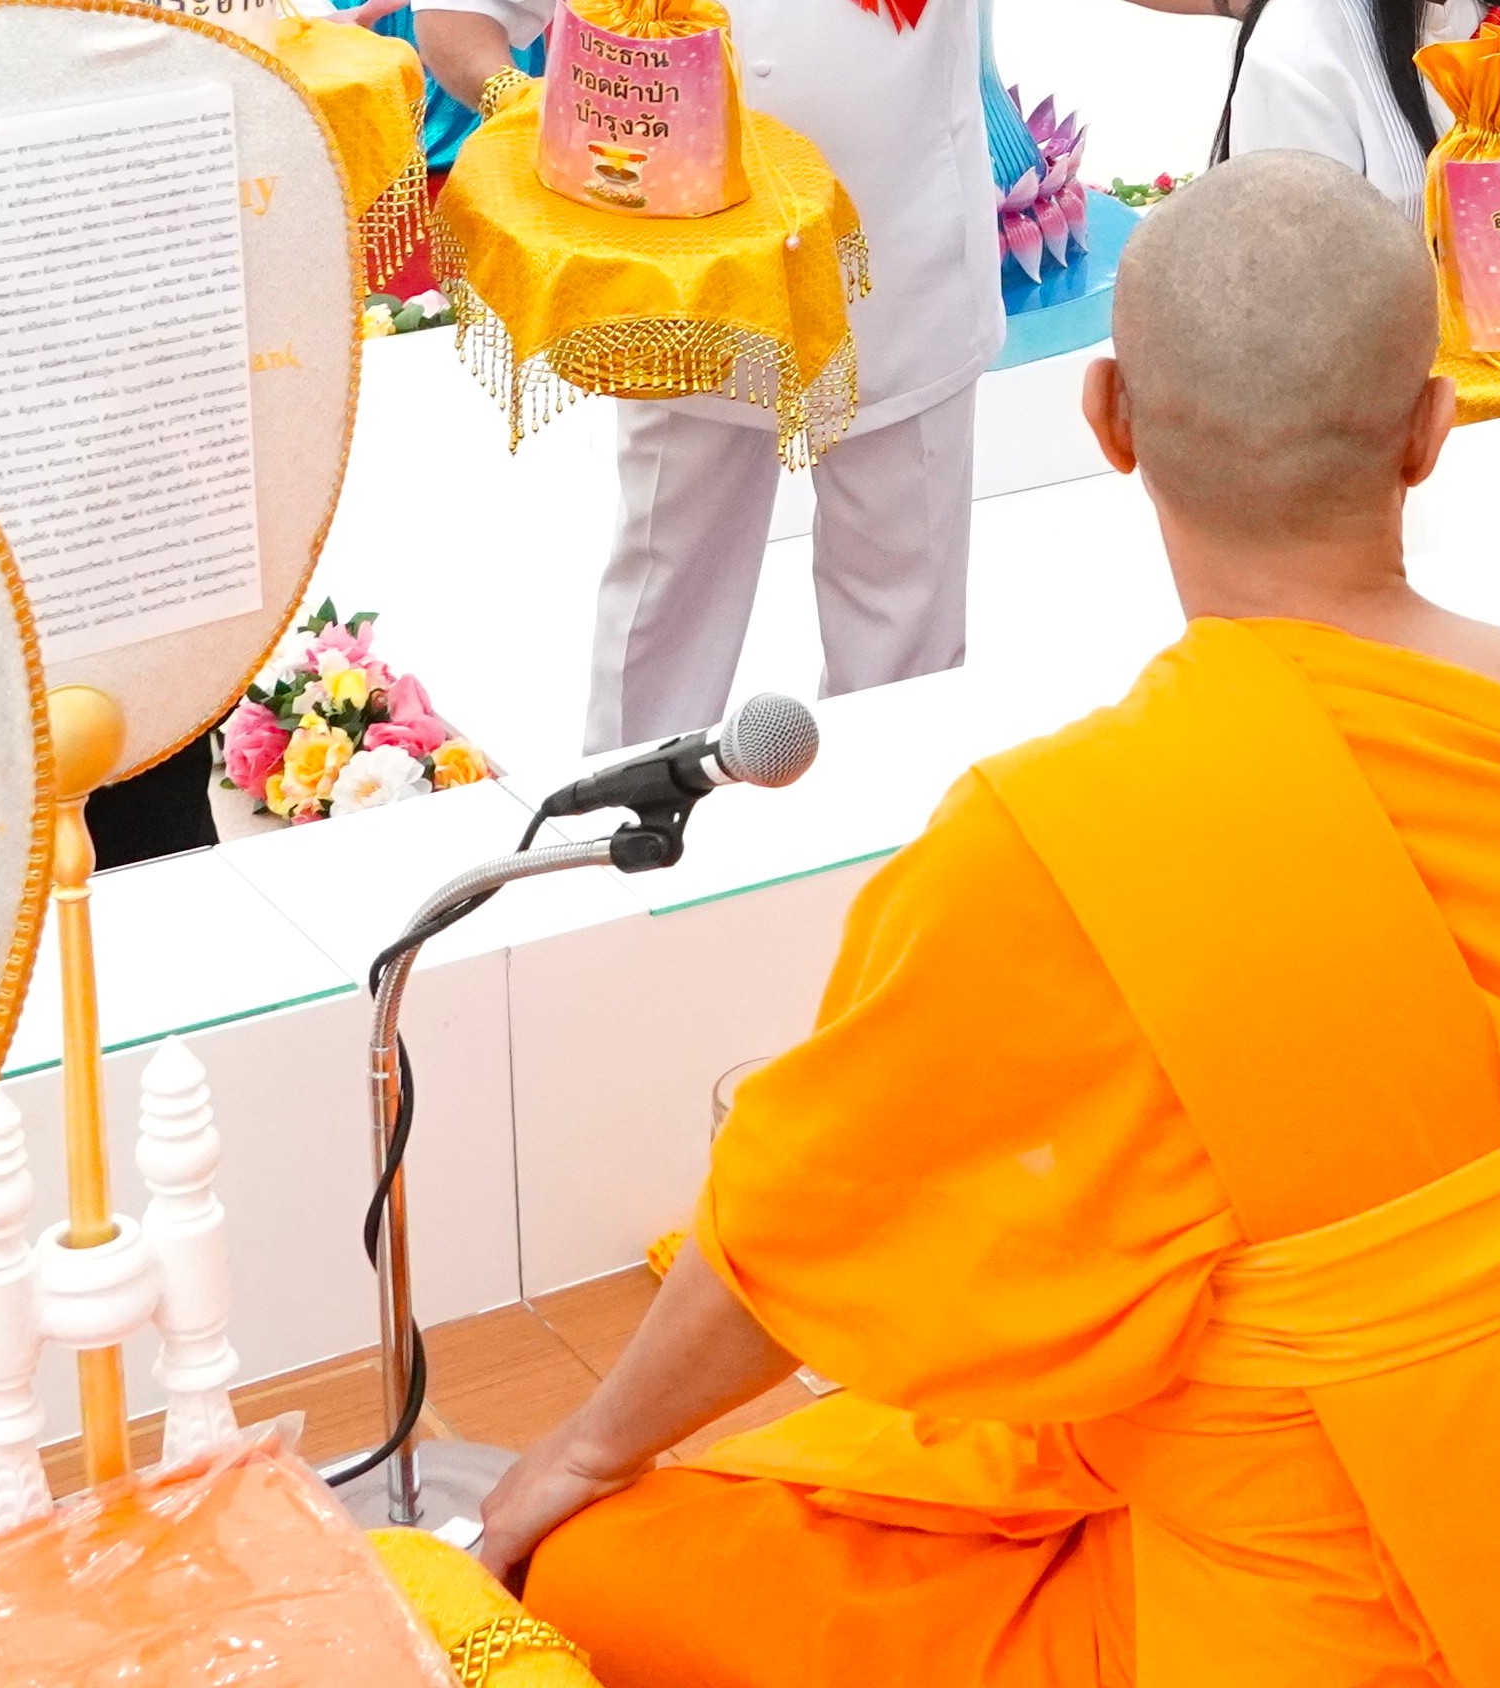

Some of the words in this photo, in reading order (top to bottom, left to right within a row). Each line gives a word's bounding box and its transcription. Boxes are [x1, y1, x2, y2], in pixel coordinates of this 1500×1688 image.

[580, 31, 670, 67] ประธาน
[571, 63, 680, 103] ทอดผ้าป่า
[575, 99, 669, 142] บำรุงวัด
